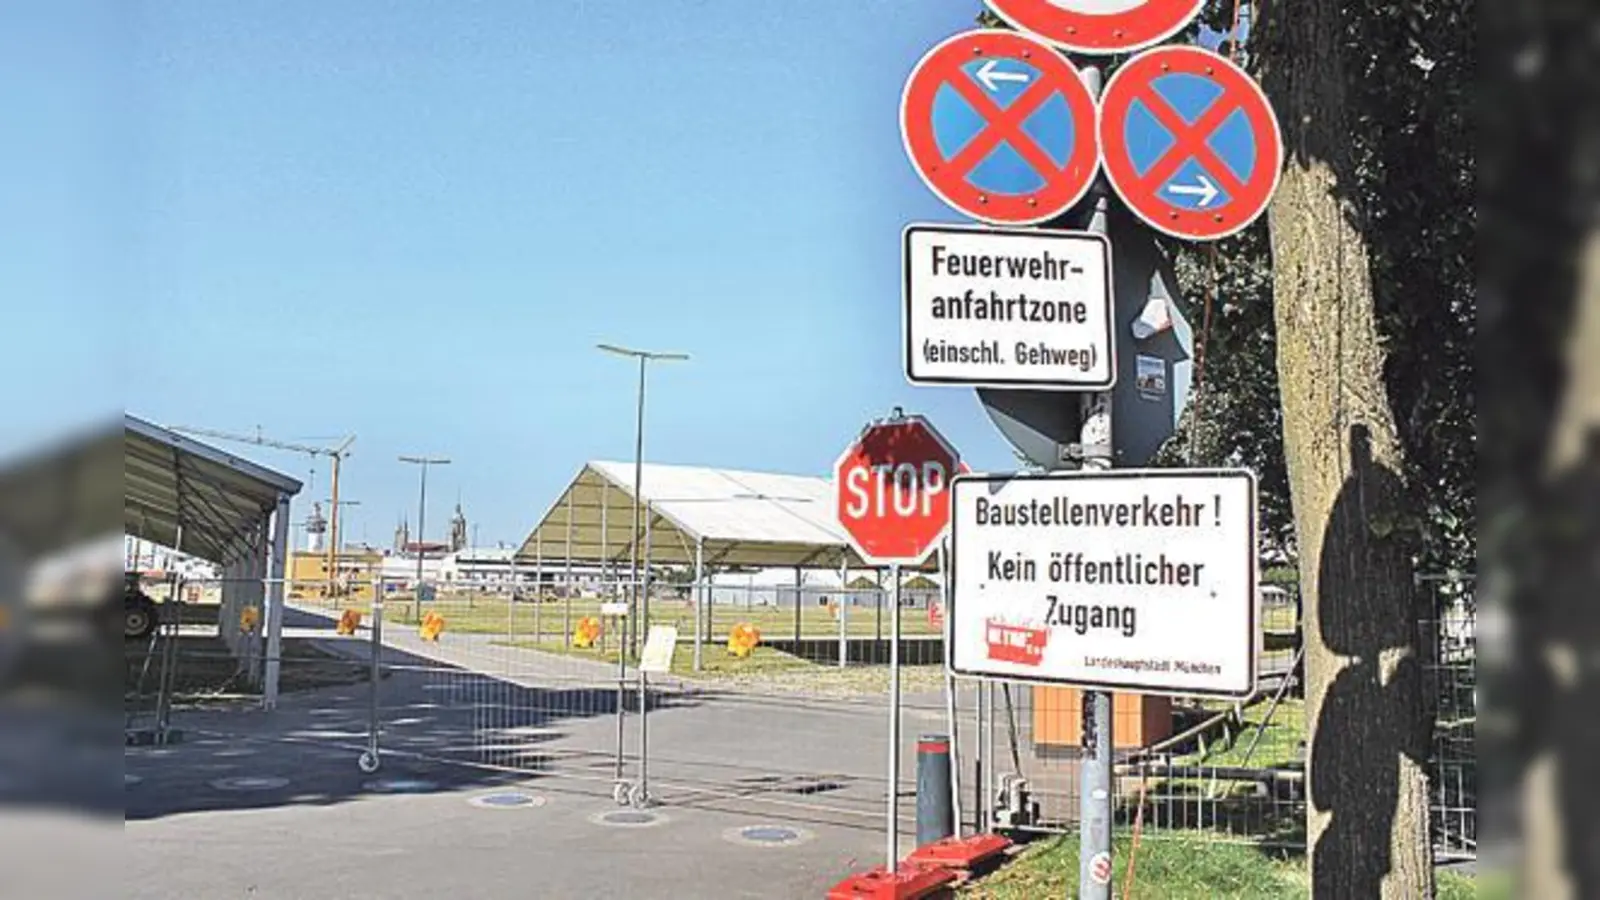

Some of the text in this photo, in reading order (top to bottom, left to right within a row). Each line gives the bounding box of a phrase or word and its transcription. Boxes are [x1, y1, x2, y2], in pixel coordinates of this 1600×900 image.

[931, 245, 1084, 281] Feuerwehr-
[931, 290, 1087, 324] anfahrtzone
[923, 339, 1097, 372] (einschl. Gehweg)
[846, 461, 945, 519] STOP
[975, 495, 1204, 527] Baustellenverkehr
[988, 551, 1204, 587] Kein öffentlicher
[1044, 595, 1136, 637] Zugang
